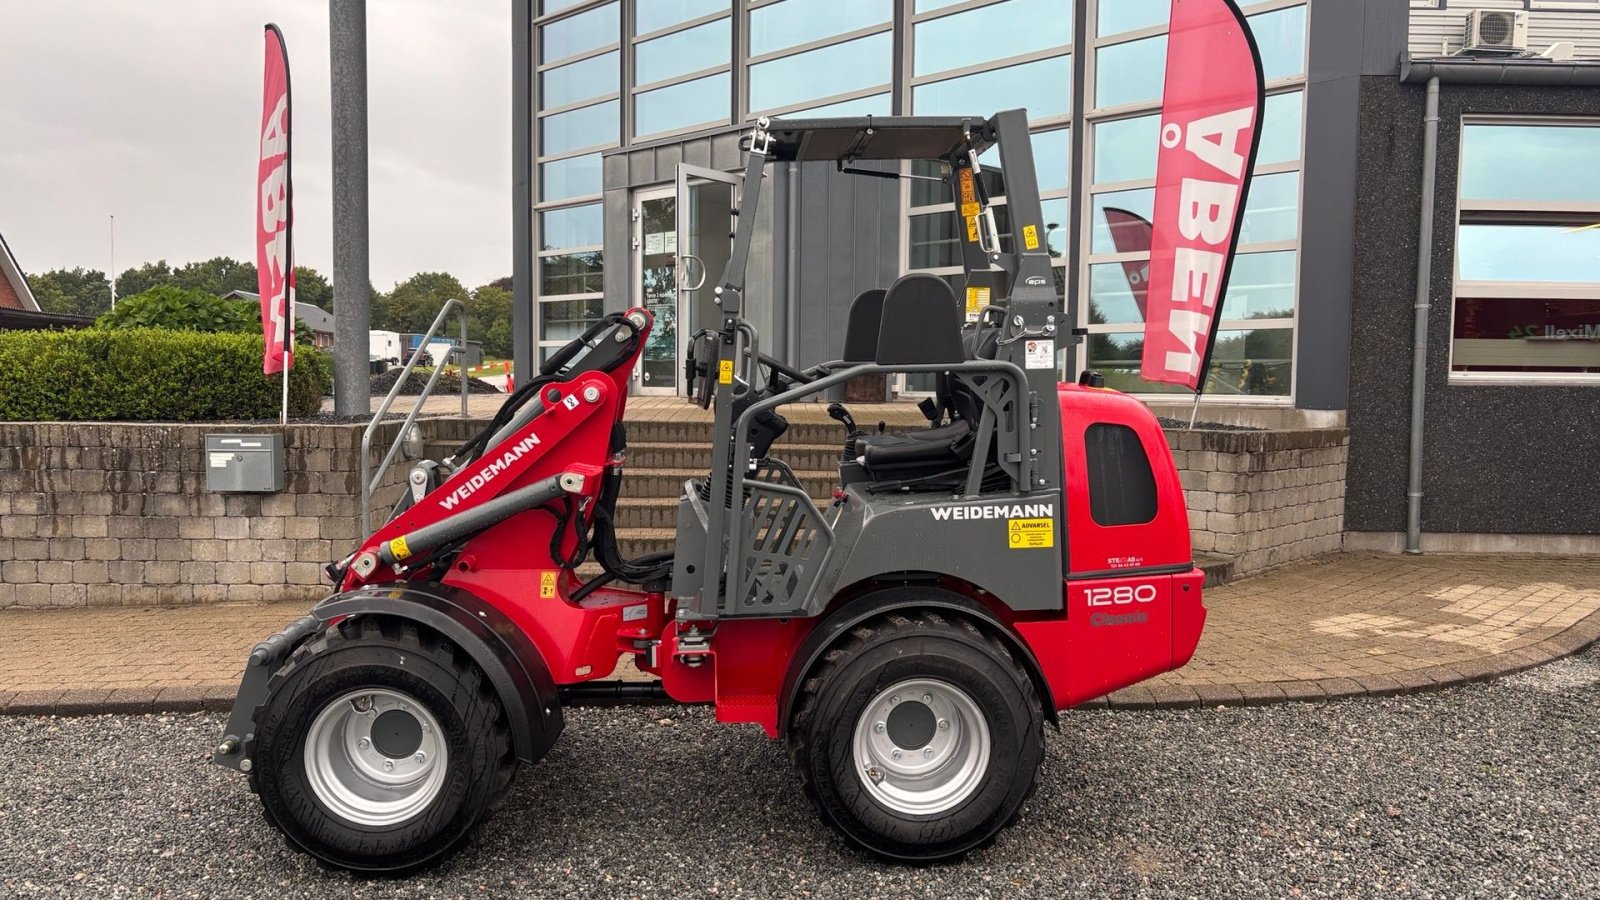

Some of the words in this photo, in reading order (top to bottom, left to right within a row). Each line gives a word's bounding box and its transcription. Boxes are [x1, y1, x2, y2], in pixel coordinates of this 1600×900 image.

[439, 432, 541, 510] WEIDEMANN
[931, 504, 1053, 520] WEIDEMANN
[1084, 585, 1156, 606] 1280
[1090, 610, 1148, 626] Classic
